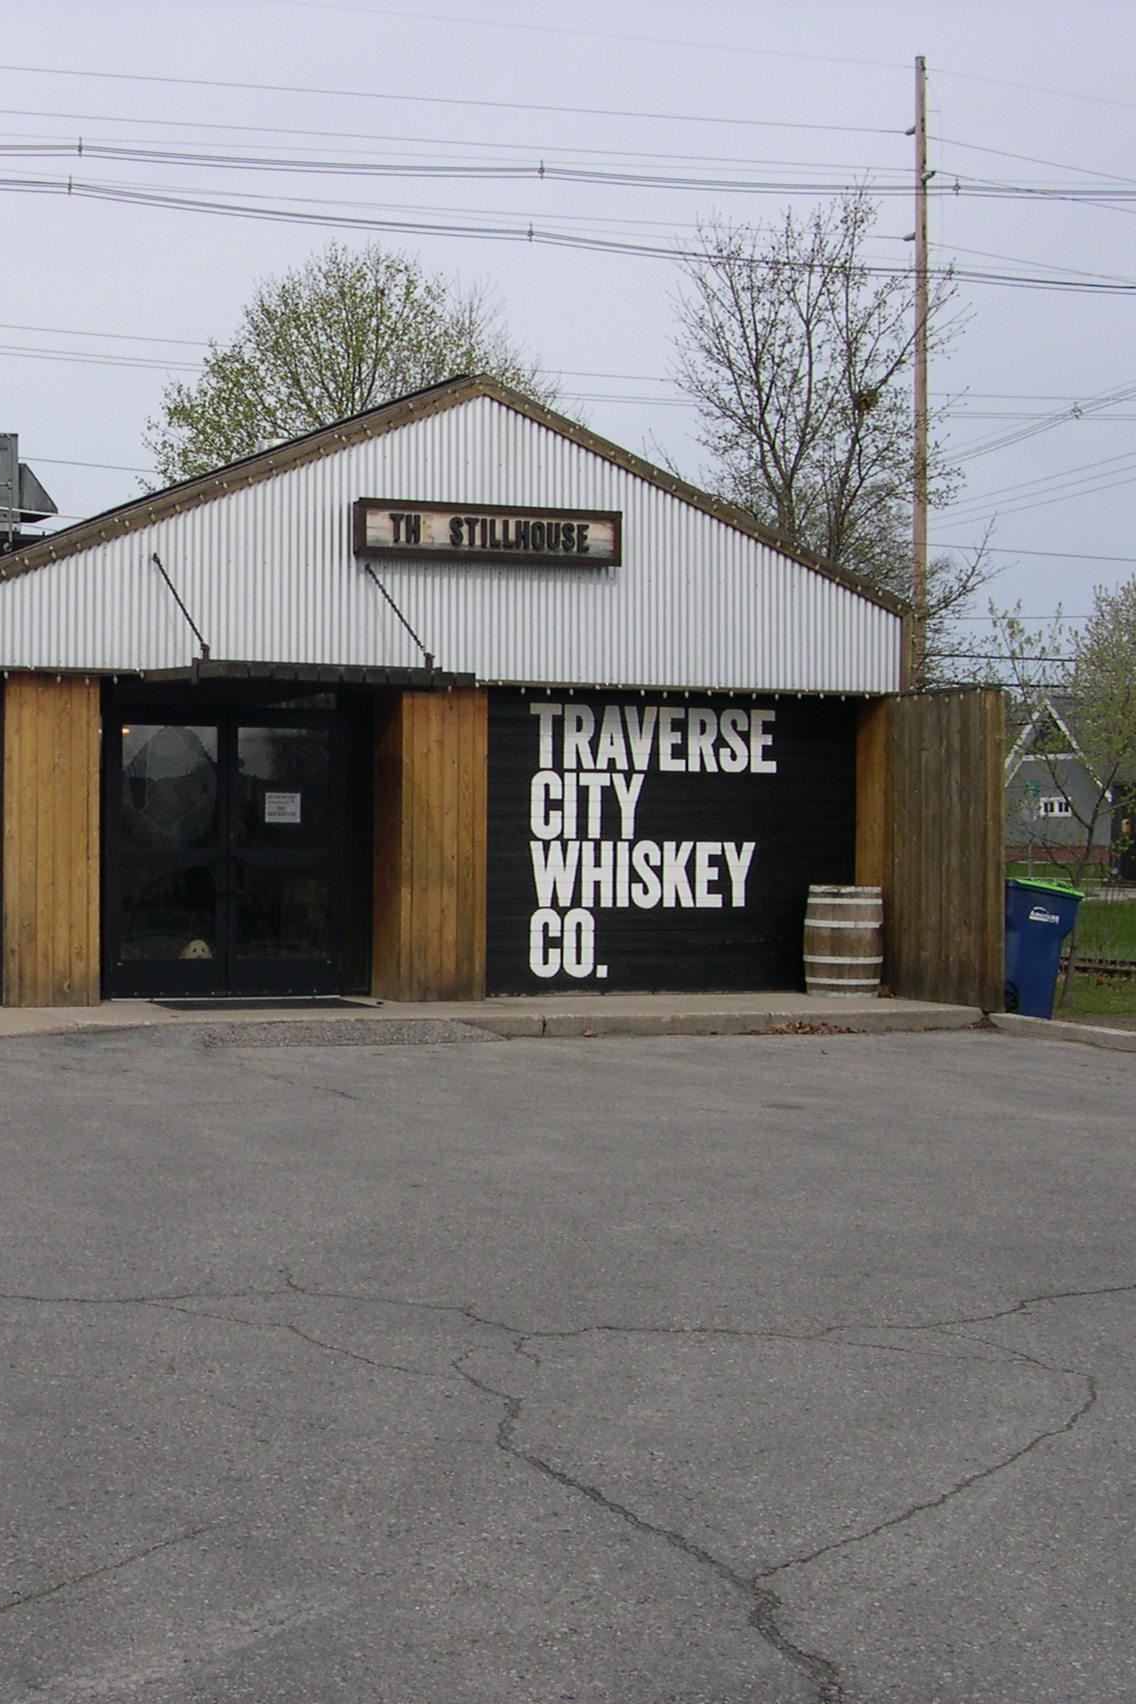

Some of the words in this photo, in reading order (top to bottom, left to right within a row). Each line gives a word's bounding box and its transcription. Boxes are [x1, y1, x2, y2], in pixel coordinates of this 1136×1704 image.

[449, 516, 590, 552] STILLHOUSE
[530, 703, 777, 773] TRAVERSE
[530, 770, 645, 840] CITY
[530, 840, 756, 909] WHISKEY
[529, 907, 608, 978] CO.
